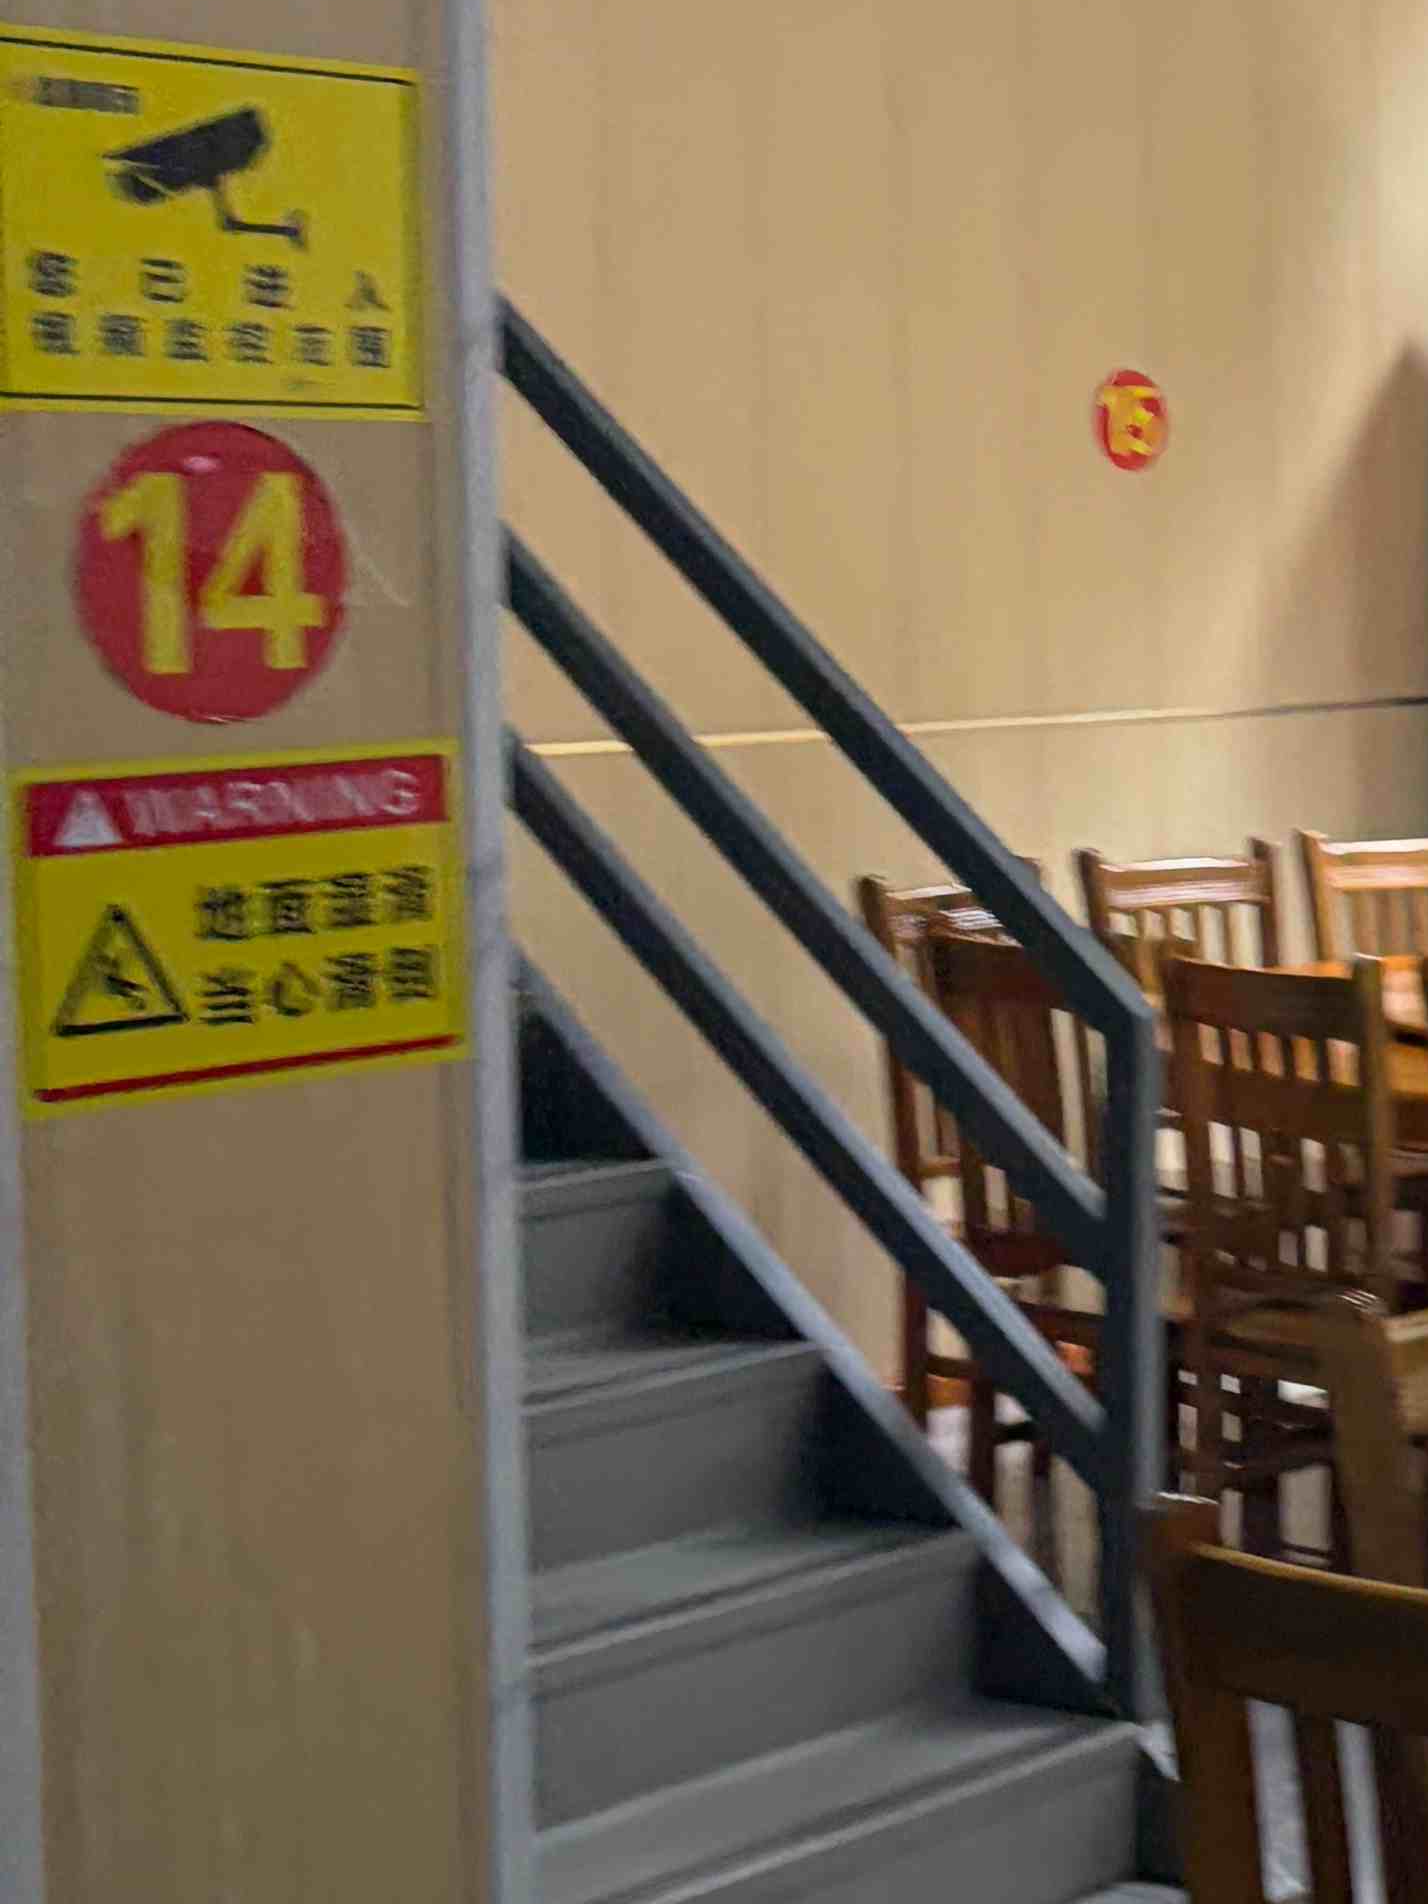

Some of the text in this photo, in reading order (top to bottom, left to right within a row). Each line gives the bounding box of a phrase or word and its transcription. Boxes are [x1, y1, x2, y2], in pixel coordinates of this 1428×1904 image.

[26, 250, 391, 310] 您已进入
[102, 471, 324, 674] 14
[124, 769, 421, 837] WARNING
[195, 865, 433, 942] 地面湿滑
[195, 944, 438, 1025] 当心滑倒
